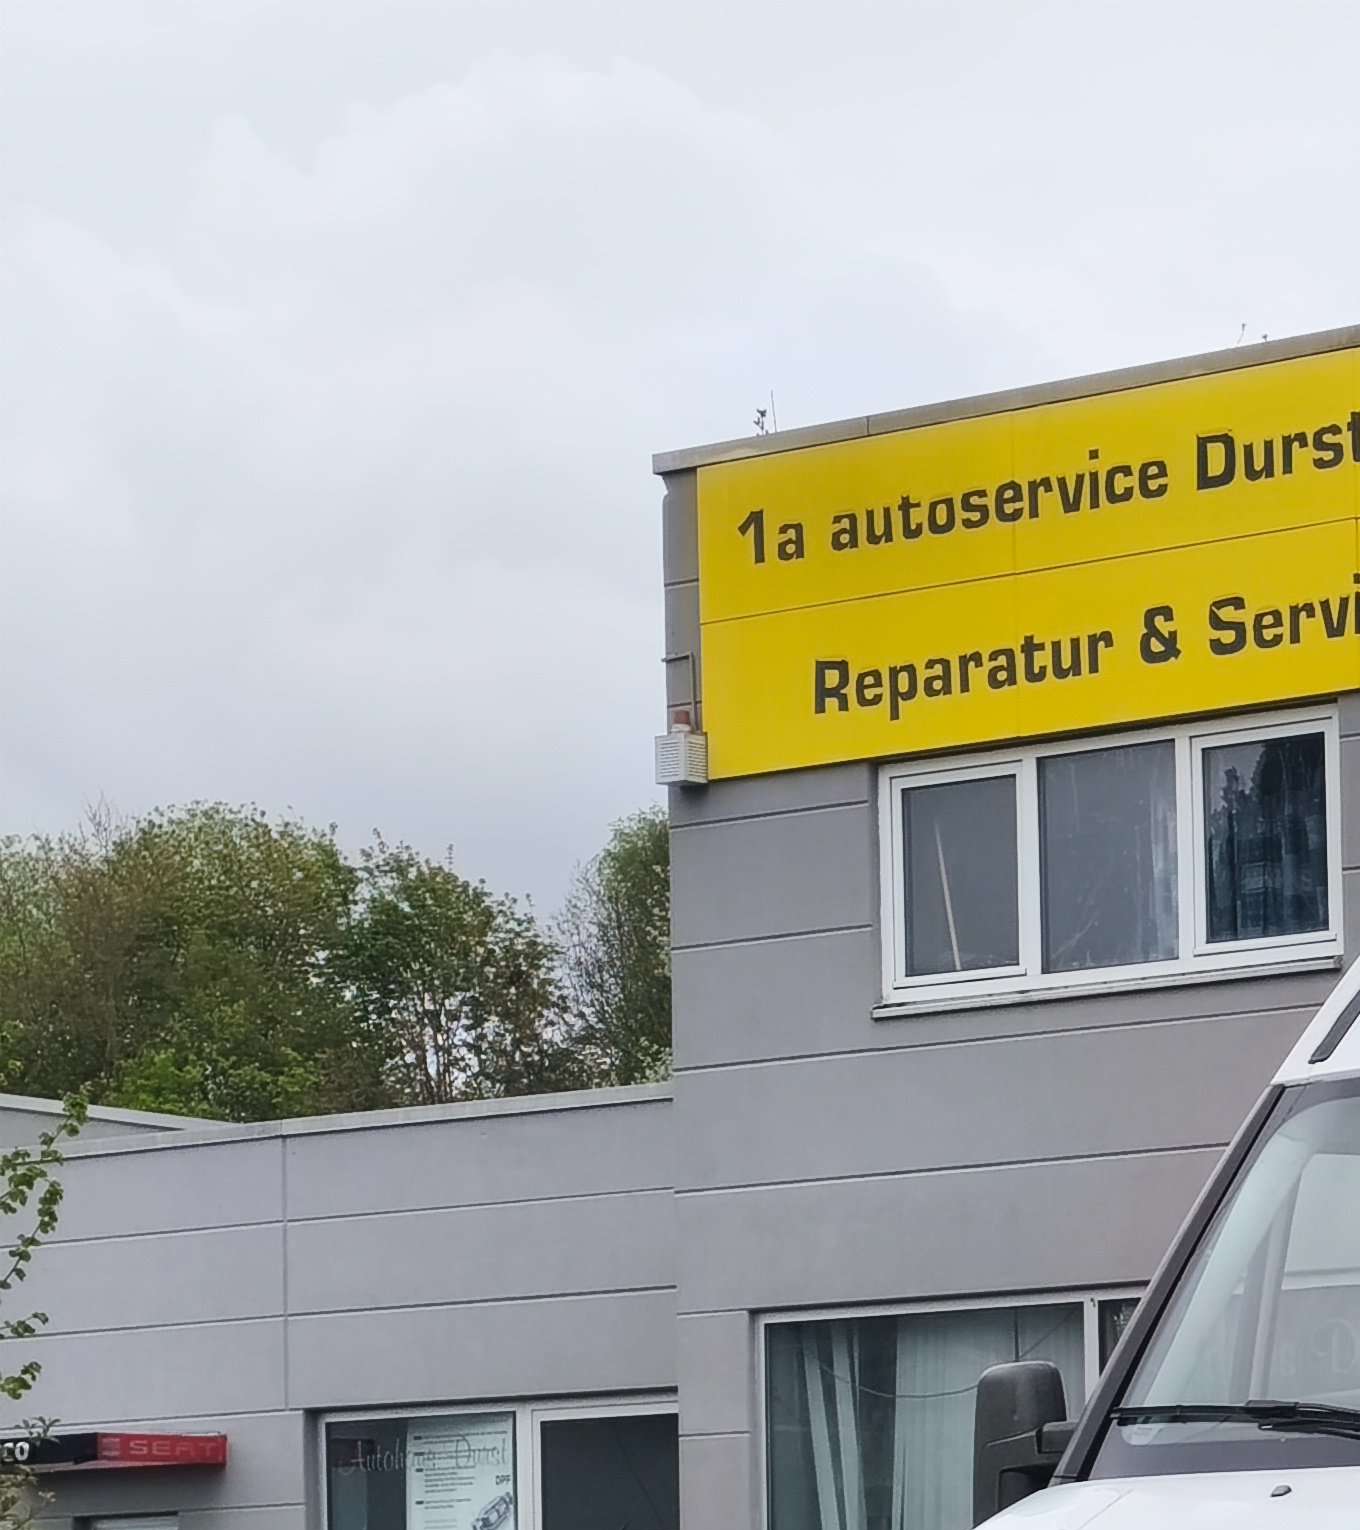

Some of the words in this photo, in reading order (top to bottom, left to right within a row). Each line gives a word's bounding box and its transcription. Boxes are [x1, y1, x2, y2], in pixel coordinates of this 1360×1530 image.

[737, 508, 804, 565] 1a
[829, 449, 1169, 550] autoservice
[813, 630, 1115, 721] Reparatur
[1139, 606, 1182, 664] &
[129, 1439, 217, 1456] SEAT
